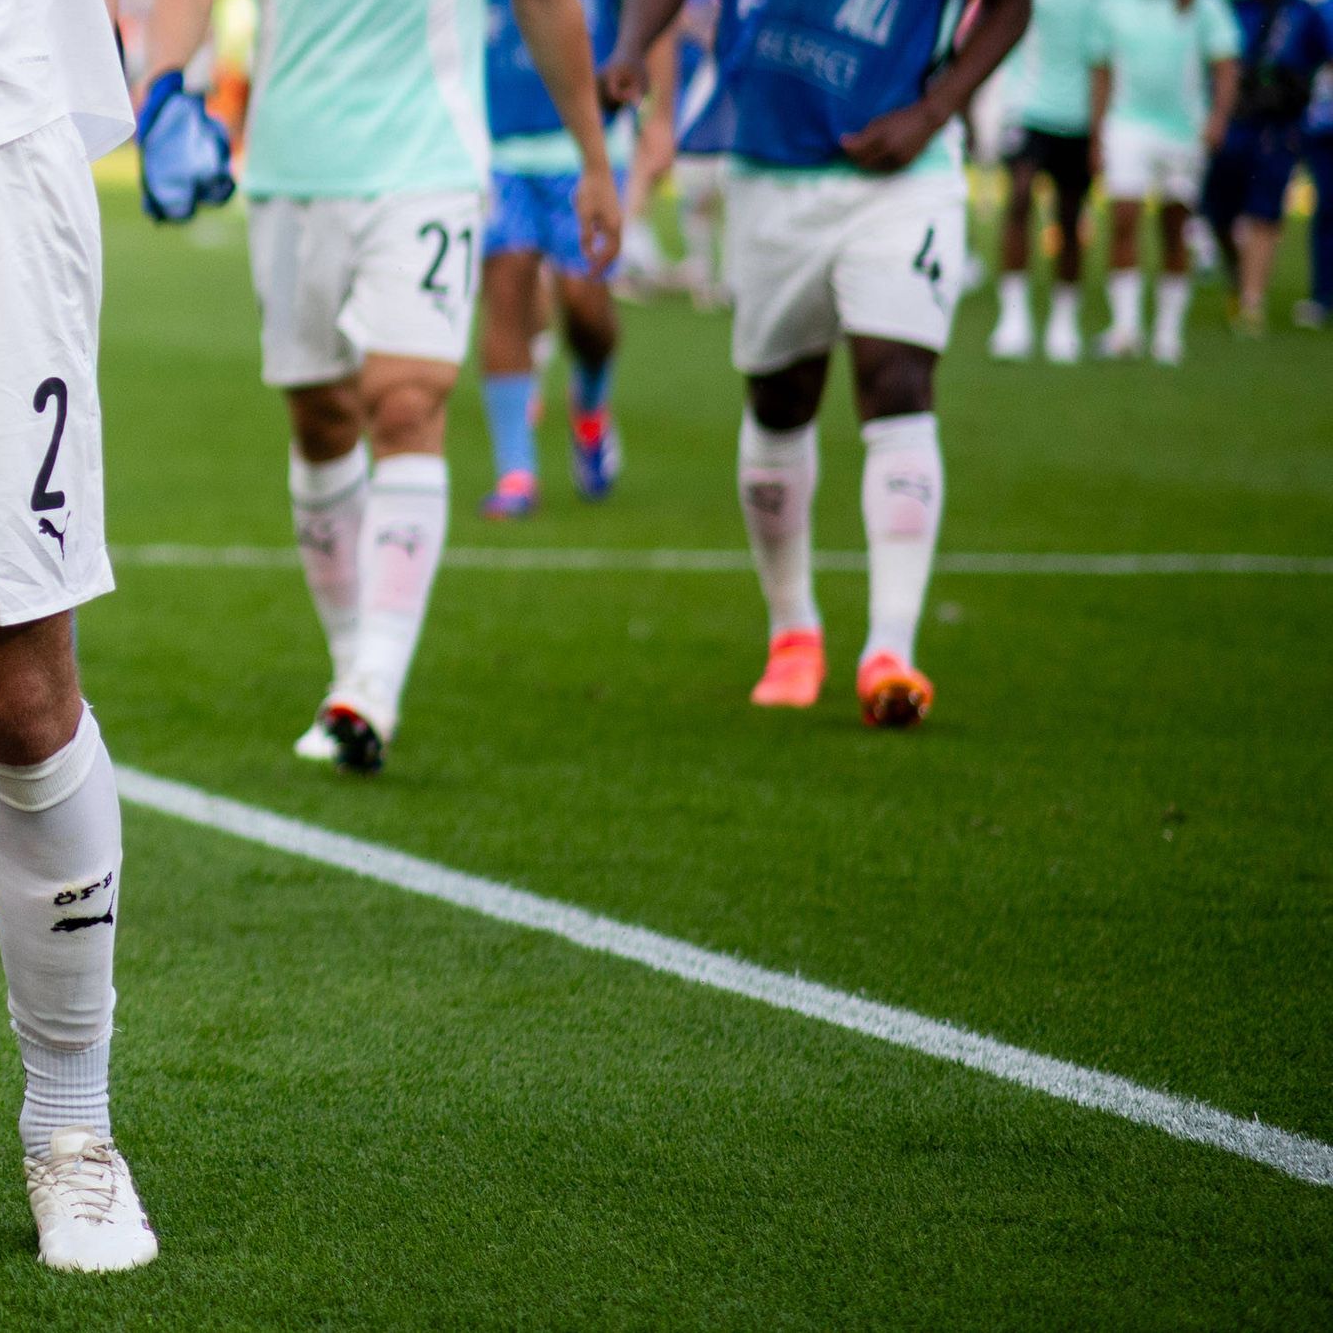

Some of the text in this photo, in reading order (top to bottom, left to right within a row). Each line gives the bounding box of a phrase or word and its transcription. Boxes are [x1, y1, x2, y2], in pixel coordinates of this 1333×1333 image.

[418, 220, 472, 300] 21
[912, 226, 941, 284] 4
[31, 377, 67, 511] 2
